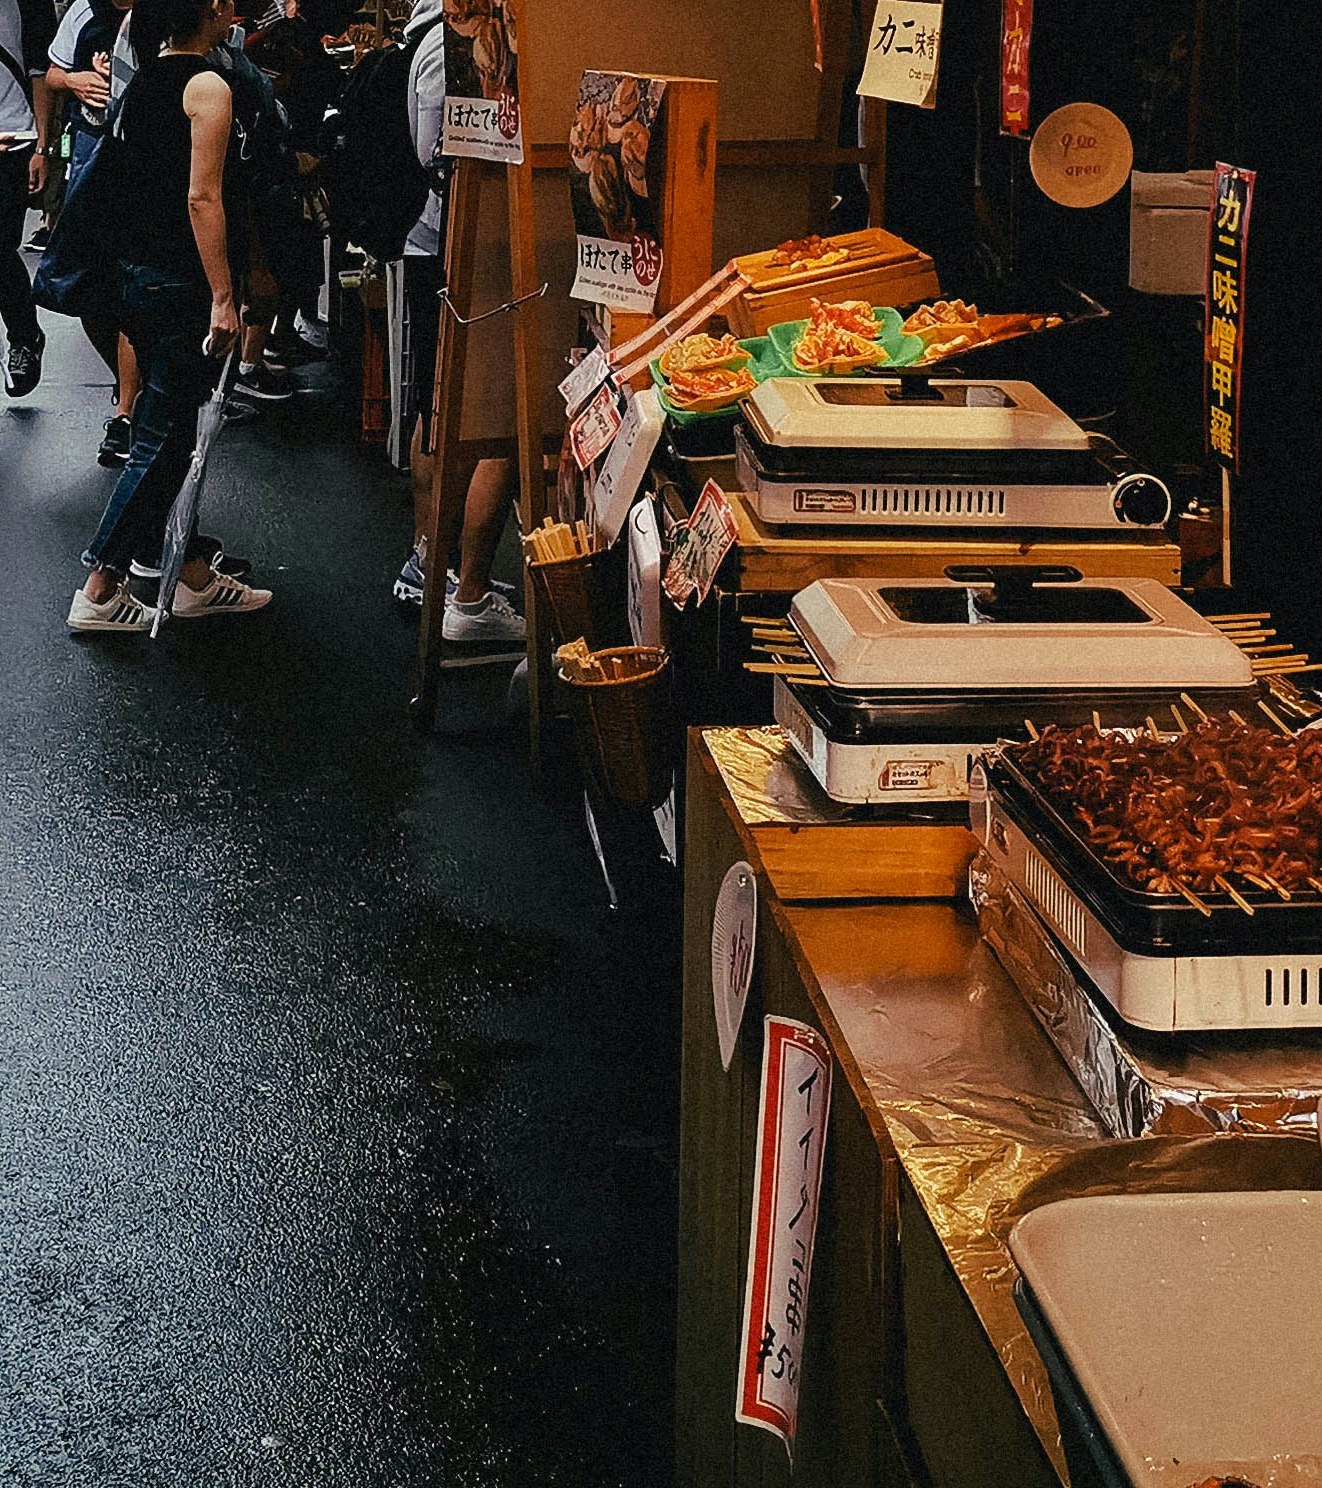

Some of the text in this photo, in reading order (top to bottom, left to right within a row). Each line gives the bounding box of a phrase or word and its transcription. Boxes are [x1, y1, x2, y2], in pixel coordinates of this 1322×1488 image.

[448, 102, 499, 133] ほたて串
[580, 243, 633, 276] ほたて串
[633, 235, 659, 261] うに
[635, 260, 655, 282] のせ
[1209, 189, 1241, 458] カニ味噌甲羅
